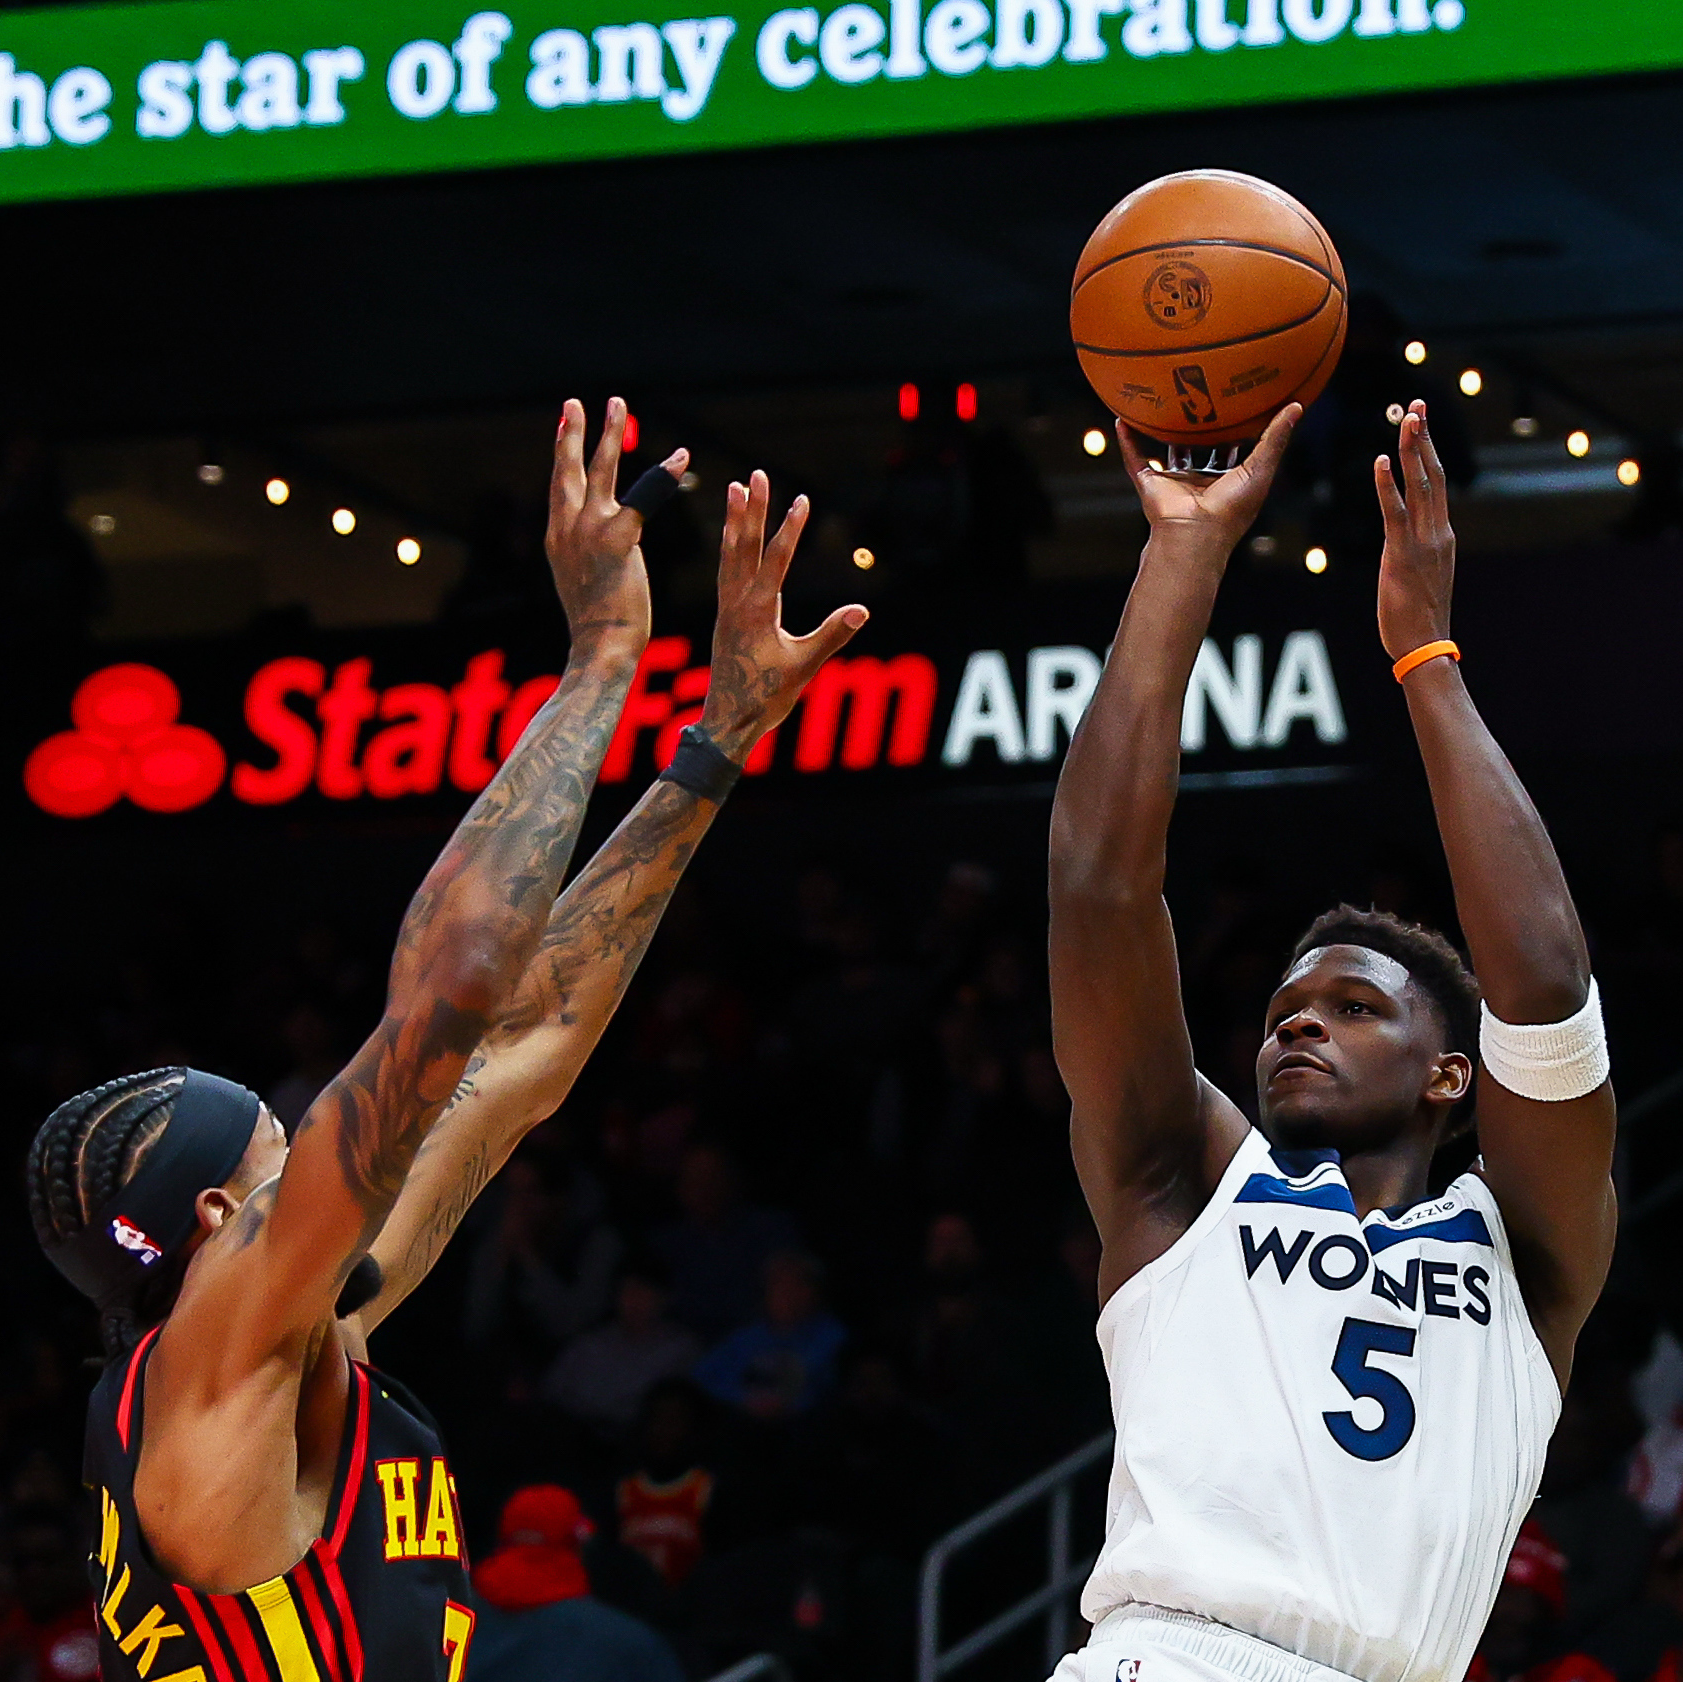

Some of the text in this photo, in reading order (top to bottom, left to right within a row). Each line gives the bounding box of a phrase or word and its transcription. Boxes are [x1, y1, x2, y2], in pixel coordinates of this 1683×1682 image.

[134, 38, 365, 140] star
[386, 9, 514, 118] of
[525, 14, 736, 122] any
[940, 628, 1348, 767] ARNA
[1396, 1200, 1456, 1227] ezzle
[1321, 1316, 1418, 1462] 5
[375, 1456, 468, 1563] HA
